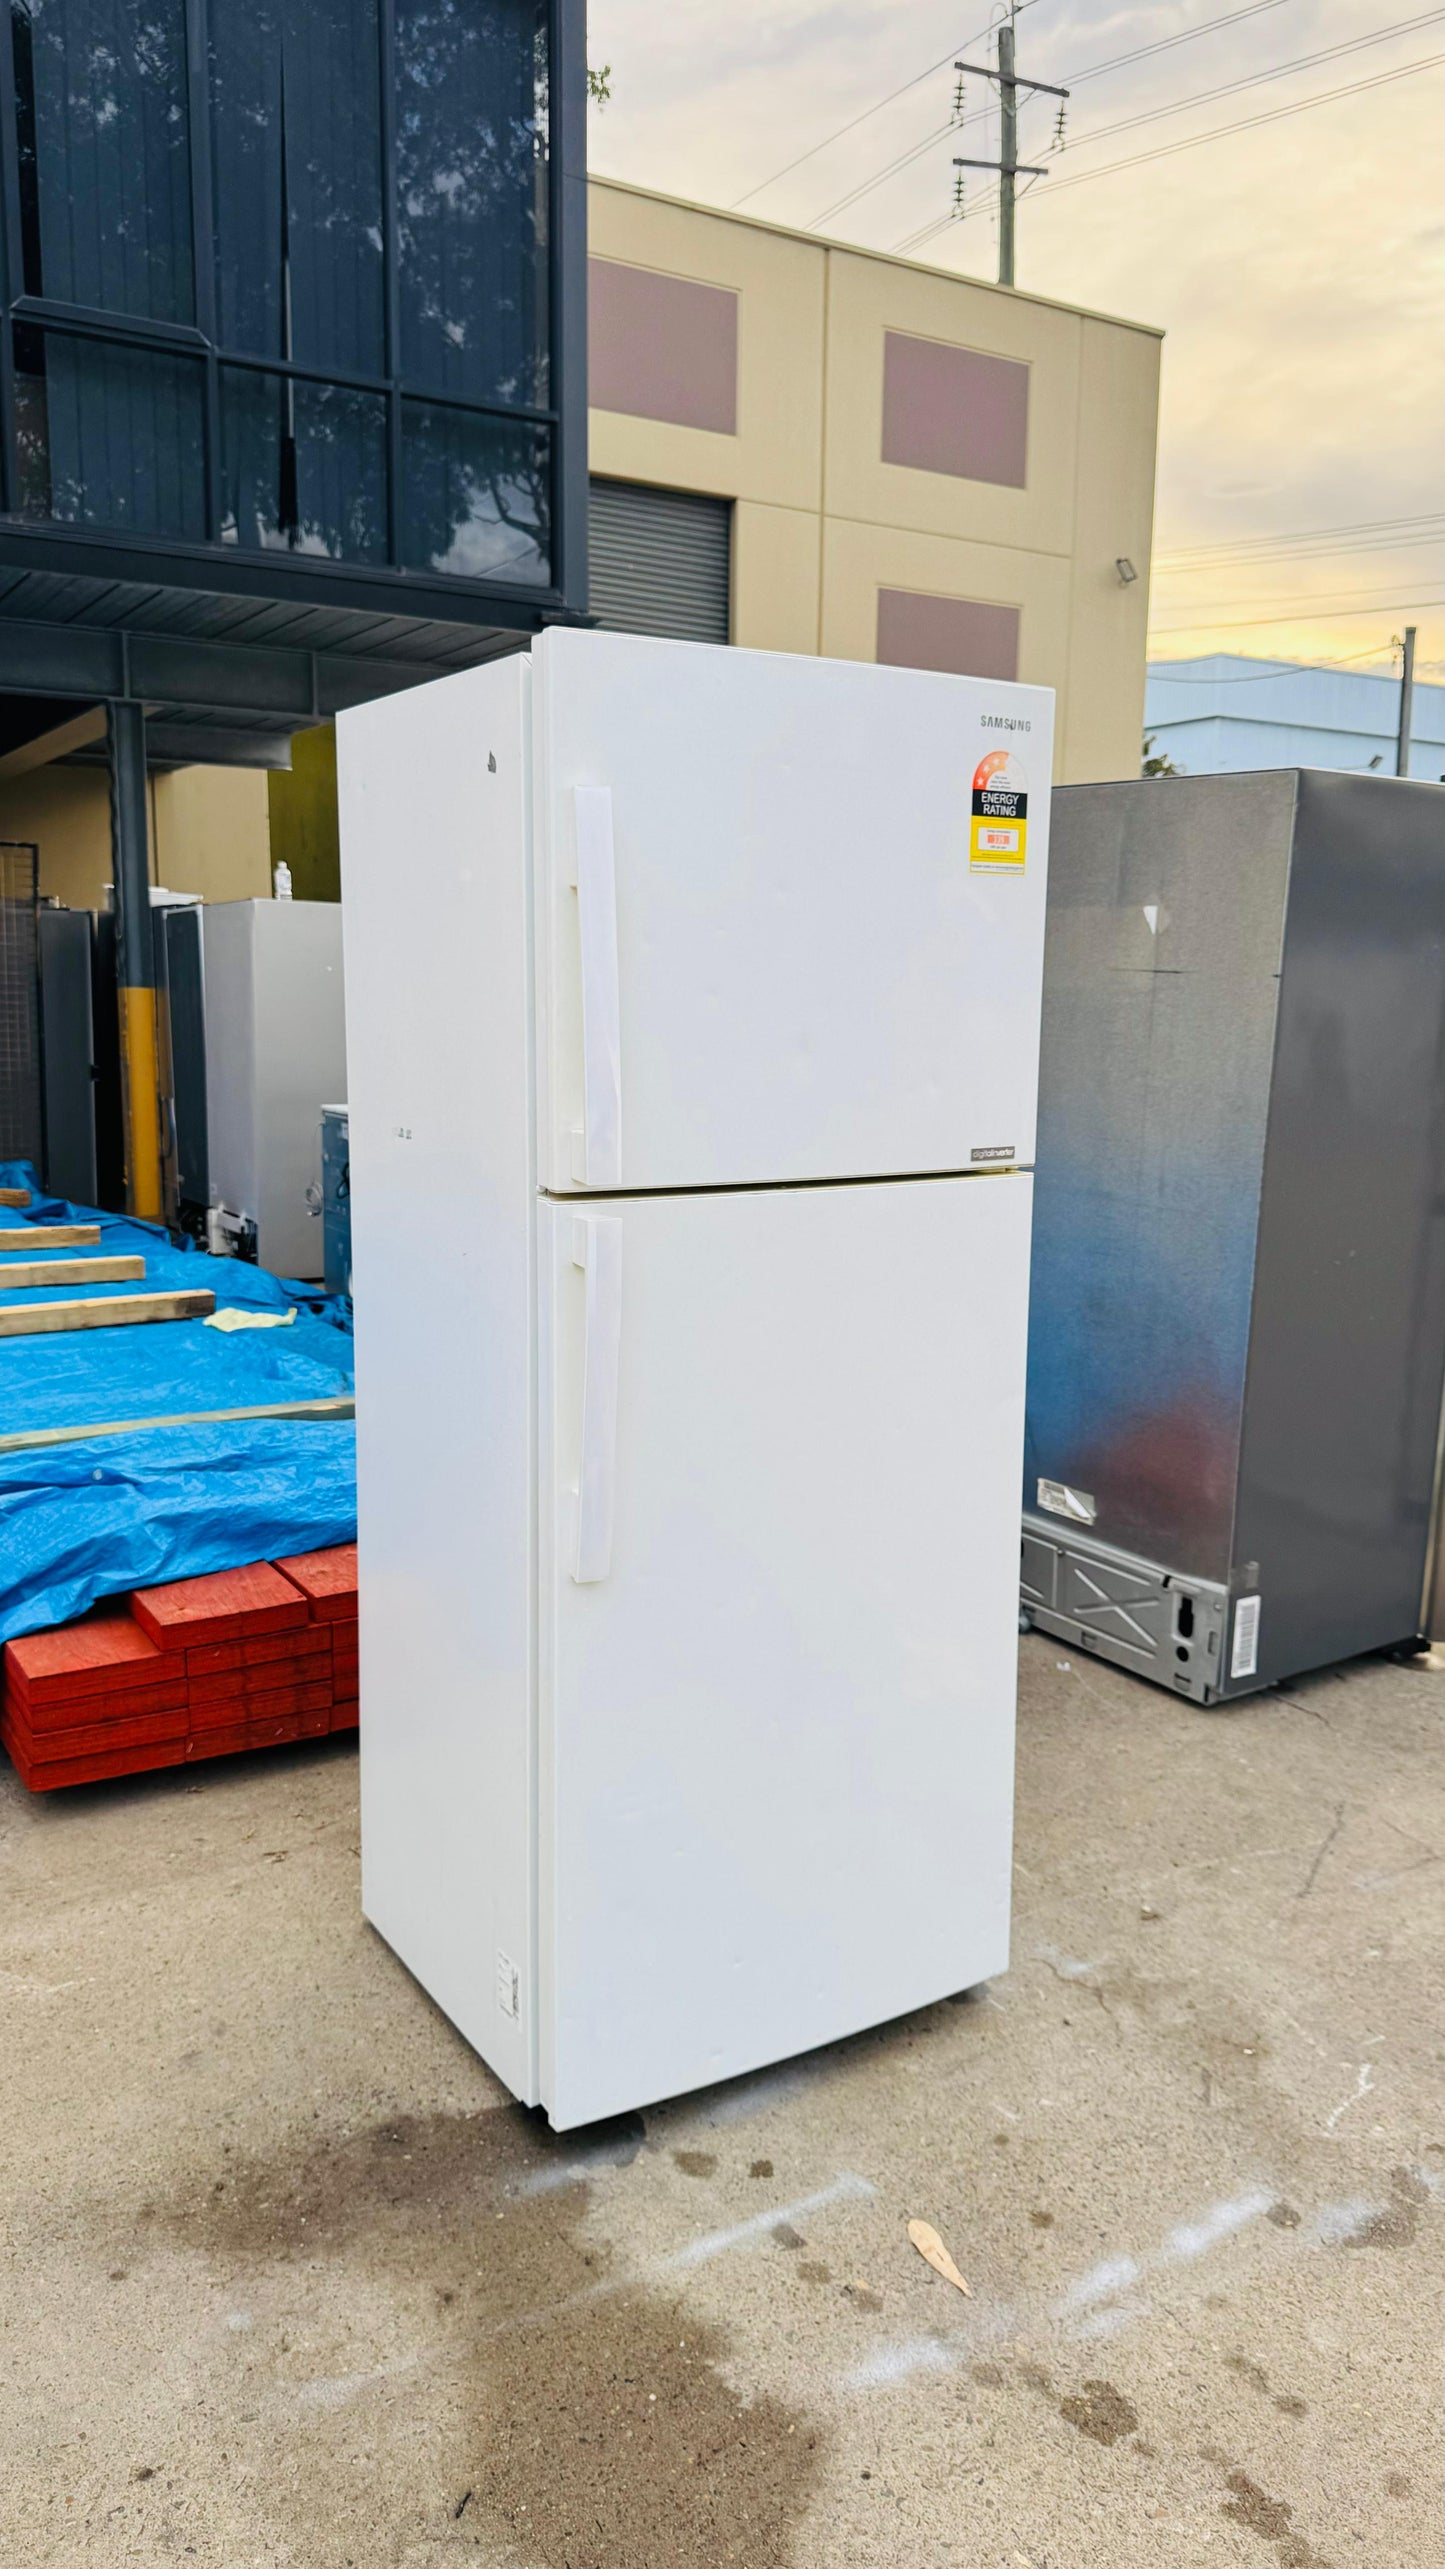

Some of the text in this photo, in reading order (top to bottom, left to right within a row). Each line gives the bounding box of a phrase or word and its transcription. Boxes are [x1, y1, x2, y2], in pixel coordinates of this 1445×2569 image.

[980, 714, 1031, 732] SAMSUNG
[981, 792, 1020, 805] ENERGY
[983, 804, 1016, 817] RATING
